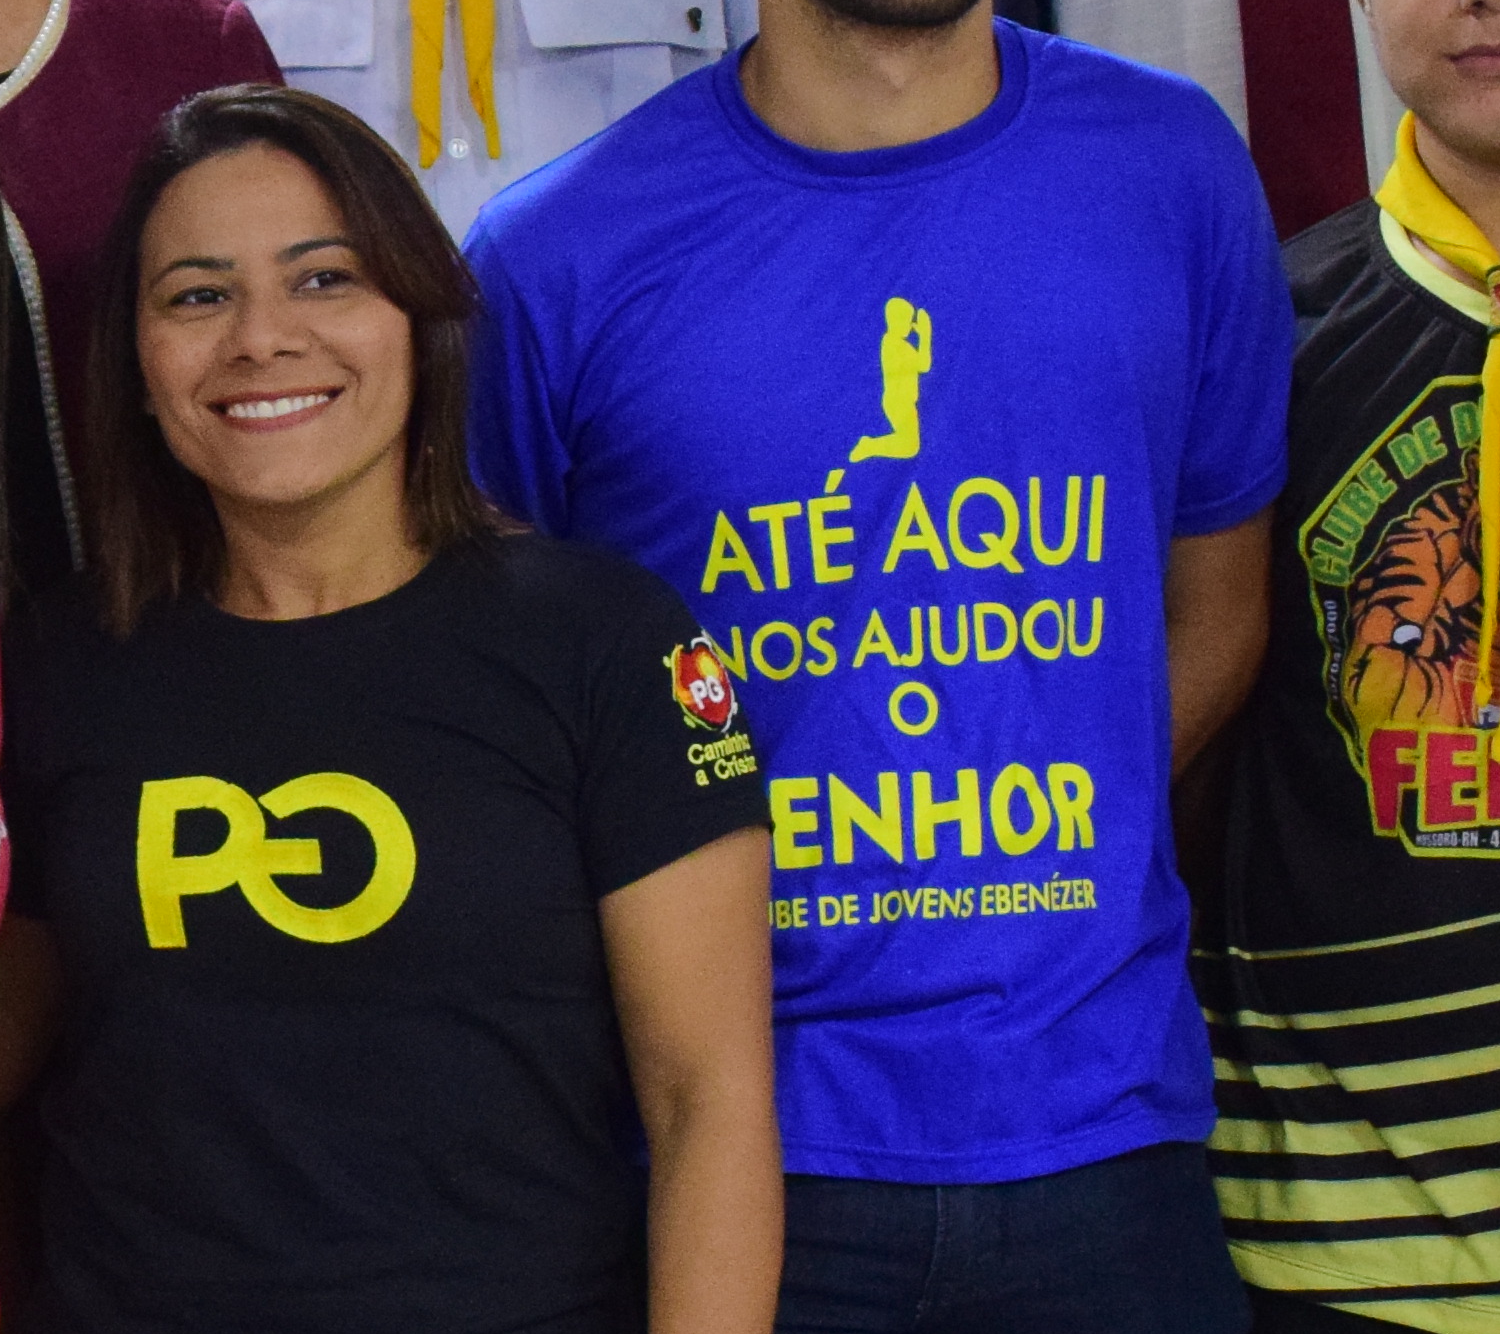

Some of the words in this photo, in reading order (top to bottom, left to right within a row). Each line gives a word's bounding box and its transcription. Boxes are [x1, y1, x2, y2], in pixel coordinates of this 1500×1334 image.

[702, 470, 854, 593] ATÉ
[884, 475, 1105, 574] AQUI
[1311, 457, 1398, 588] CLUBE
[1387, 415, 1449, 481] DE
[853, 597, 1103, 668] AJUDOU
[689, 676, 725, 711] PG
[888, 680, 939, 736] O
[694, 768, 710, 787] a
[769, 763, 1095, 870] ENHOR
[818, 894, 860, 927] DE
[869, 888, 974, 924] JOVENS
[981, 871, 1097, 916] EBENÉZER
